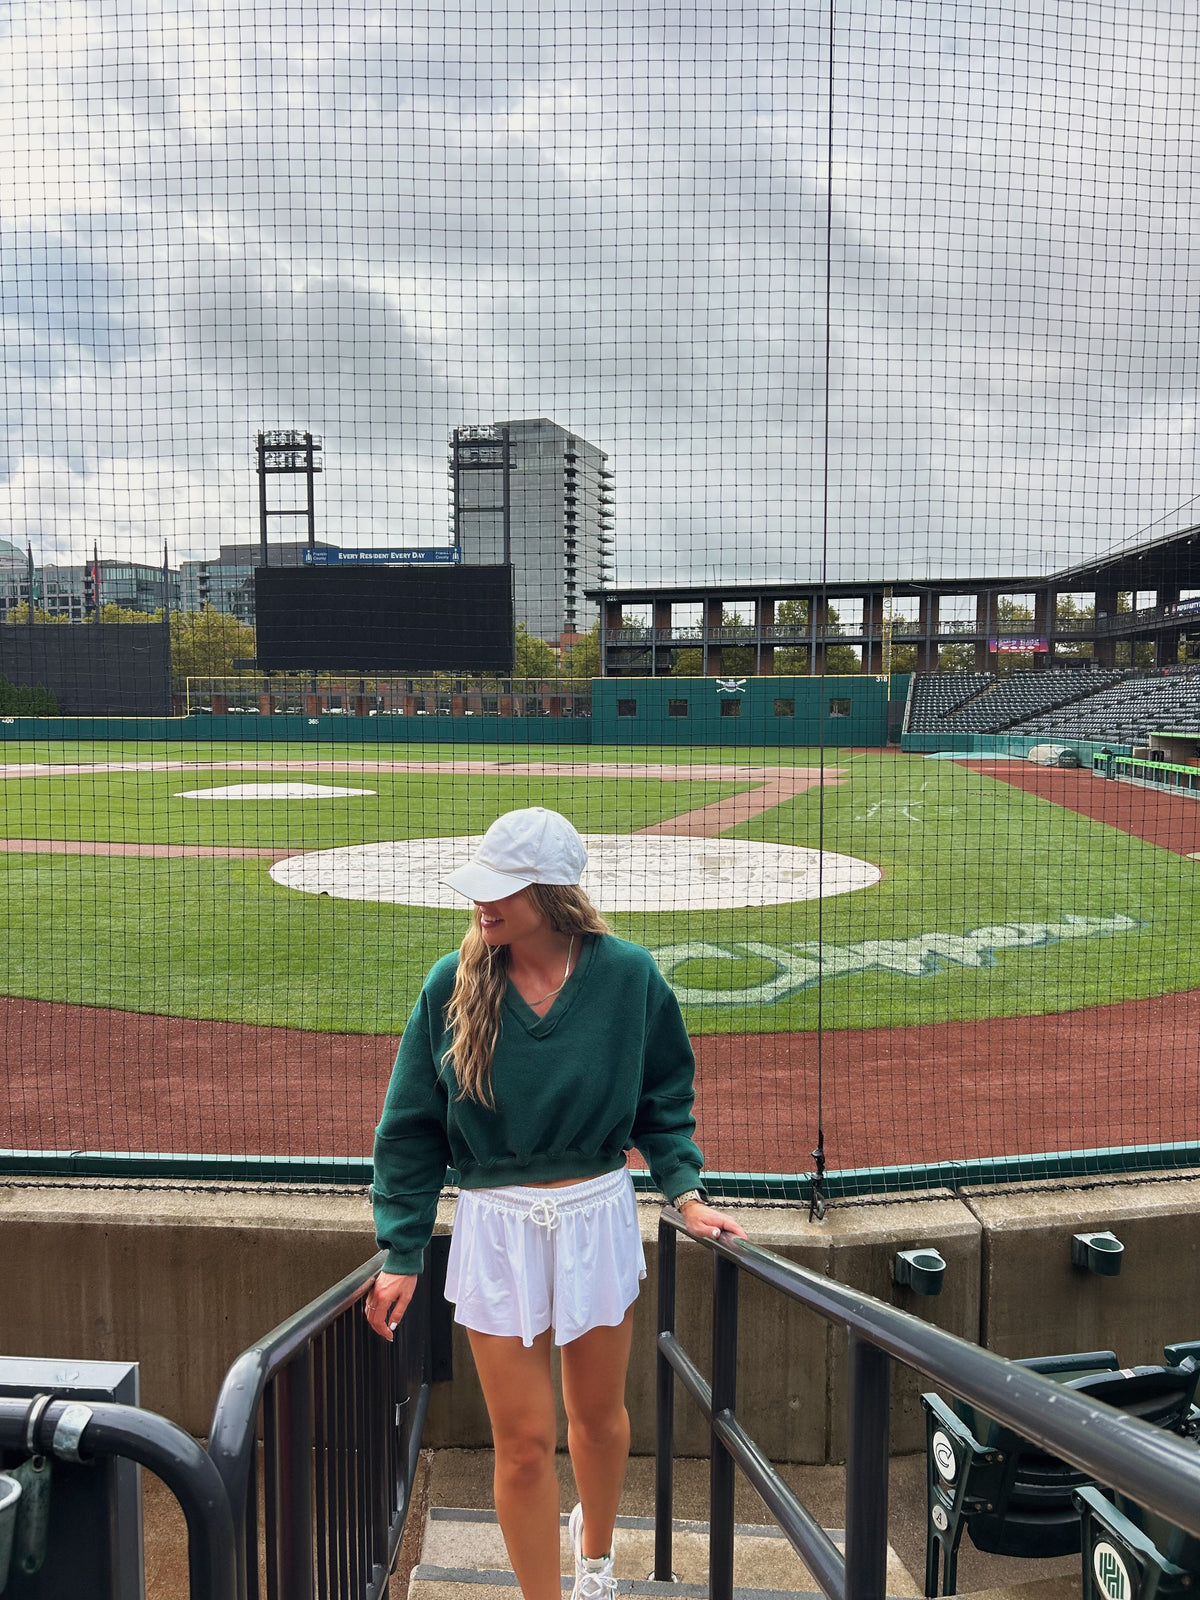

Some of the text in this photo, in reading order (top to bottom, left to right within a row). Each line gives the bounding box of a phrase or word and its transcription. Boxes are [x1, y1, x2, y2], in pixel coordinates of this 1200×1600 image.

[338, 551, 425, 560] EVERY RESIDENT EVERY DAY
